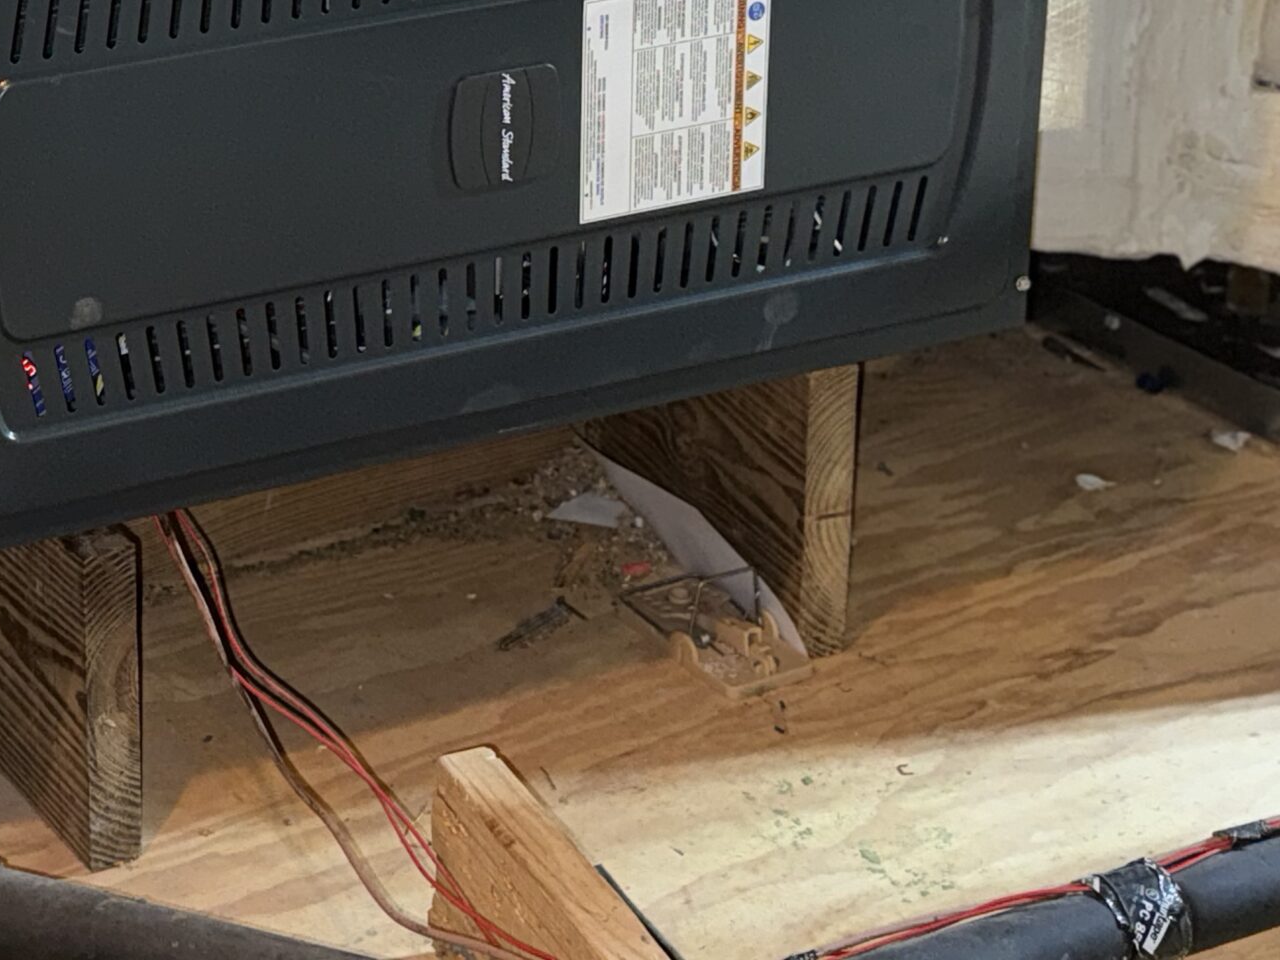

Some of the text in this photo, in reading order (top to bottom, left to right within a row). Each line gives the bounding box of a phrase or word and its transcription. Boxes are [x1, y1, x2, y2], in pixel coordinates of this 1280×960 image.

[501, 73, 516, 182] American Standard
[1139, 900, 1154, 922] PC
